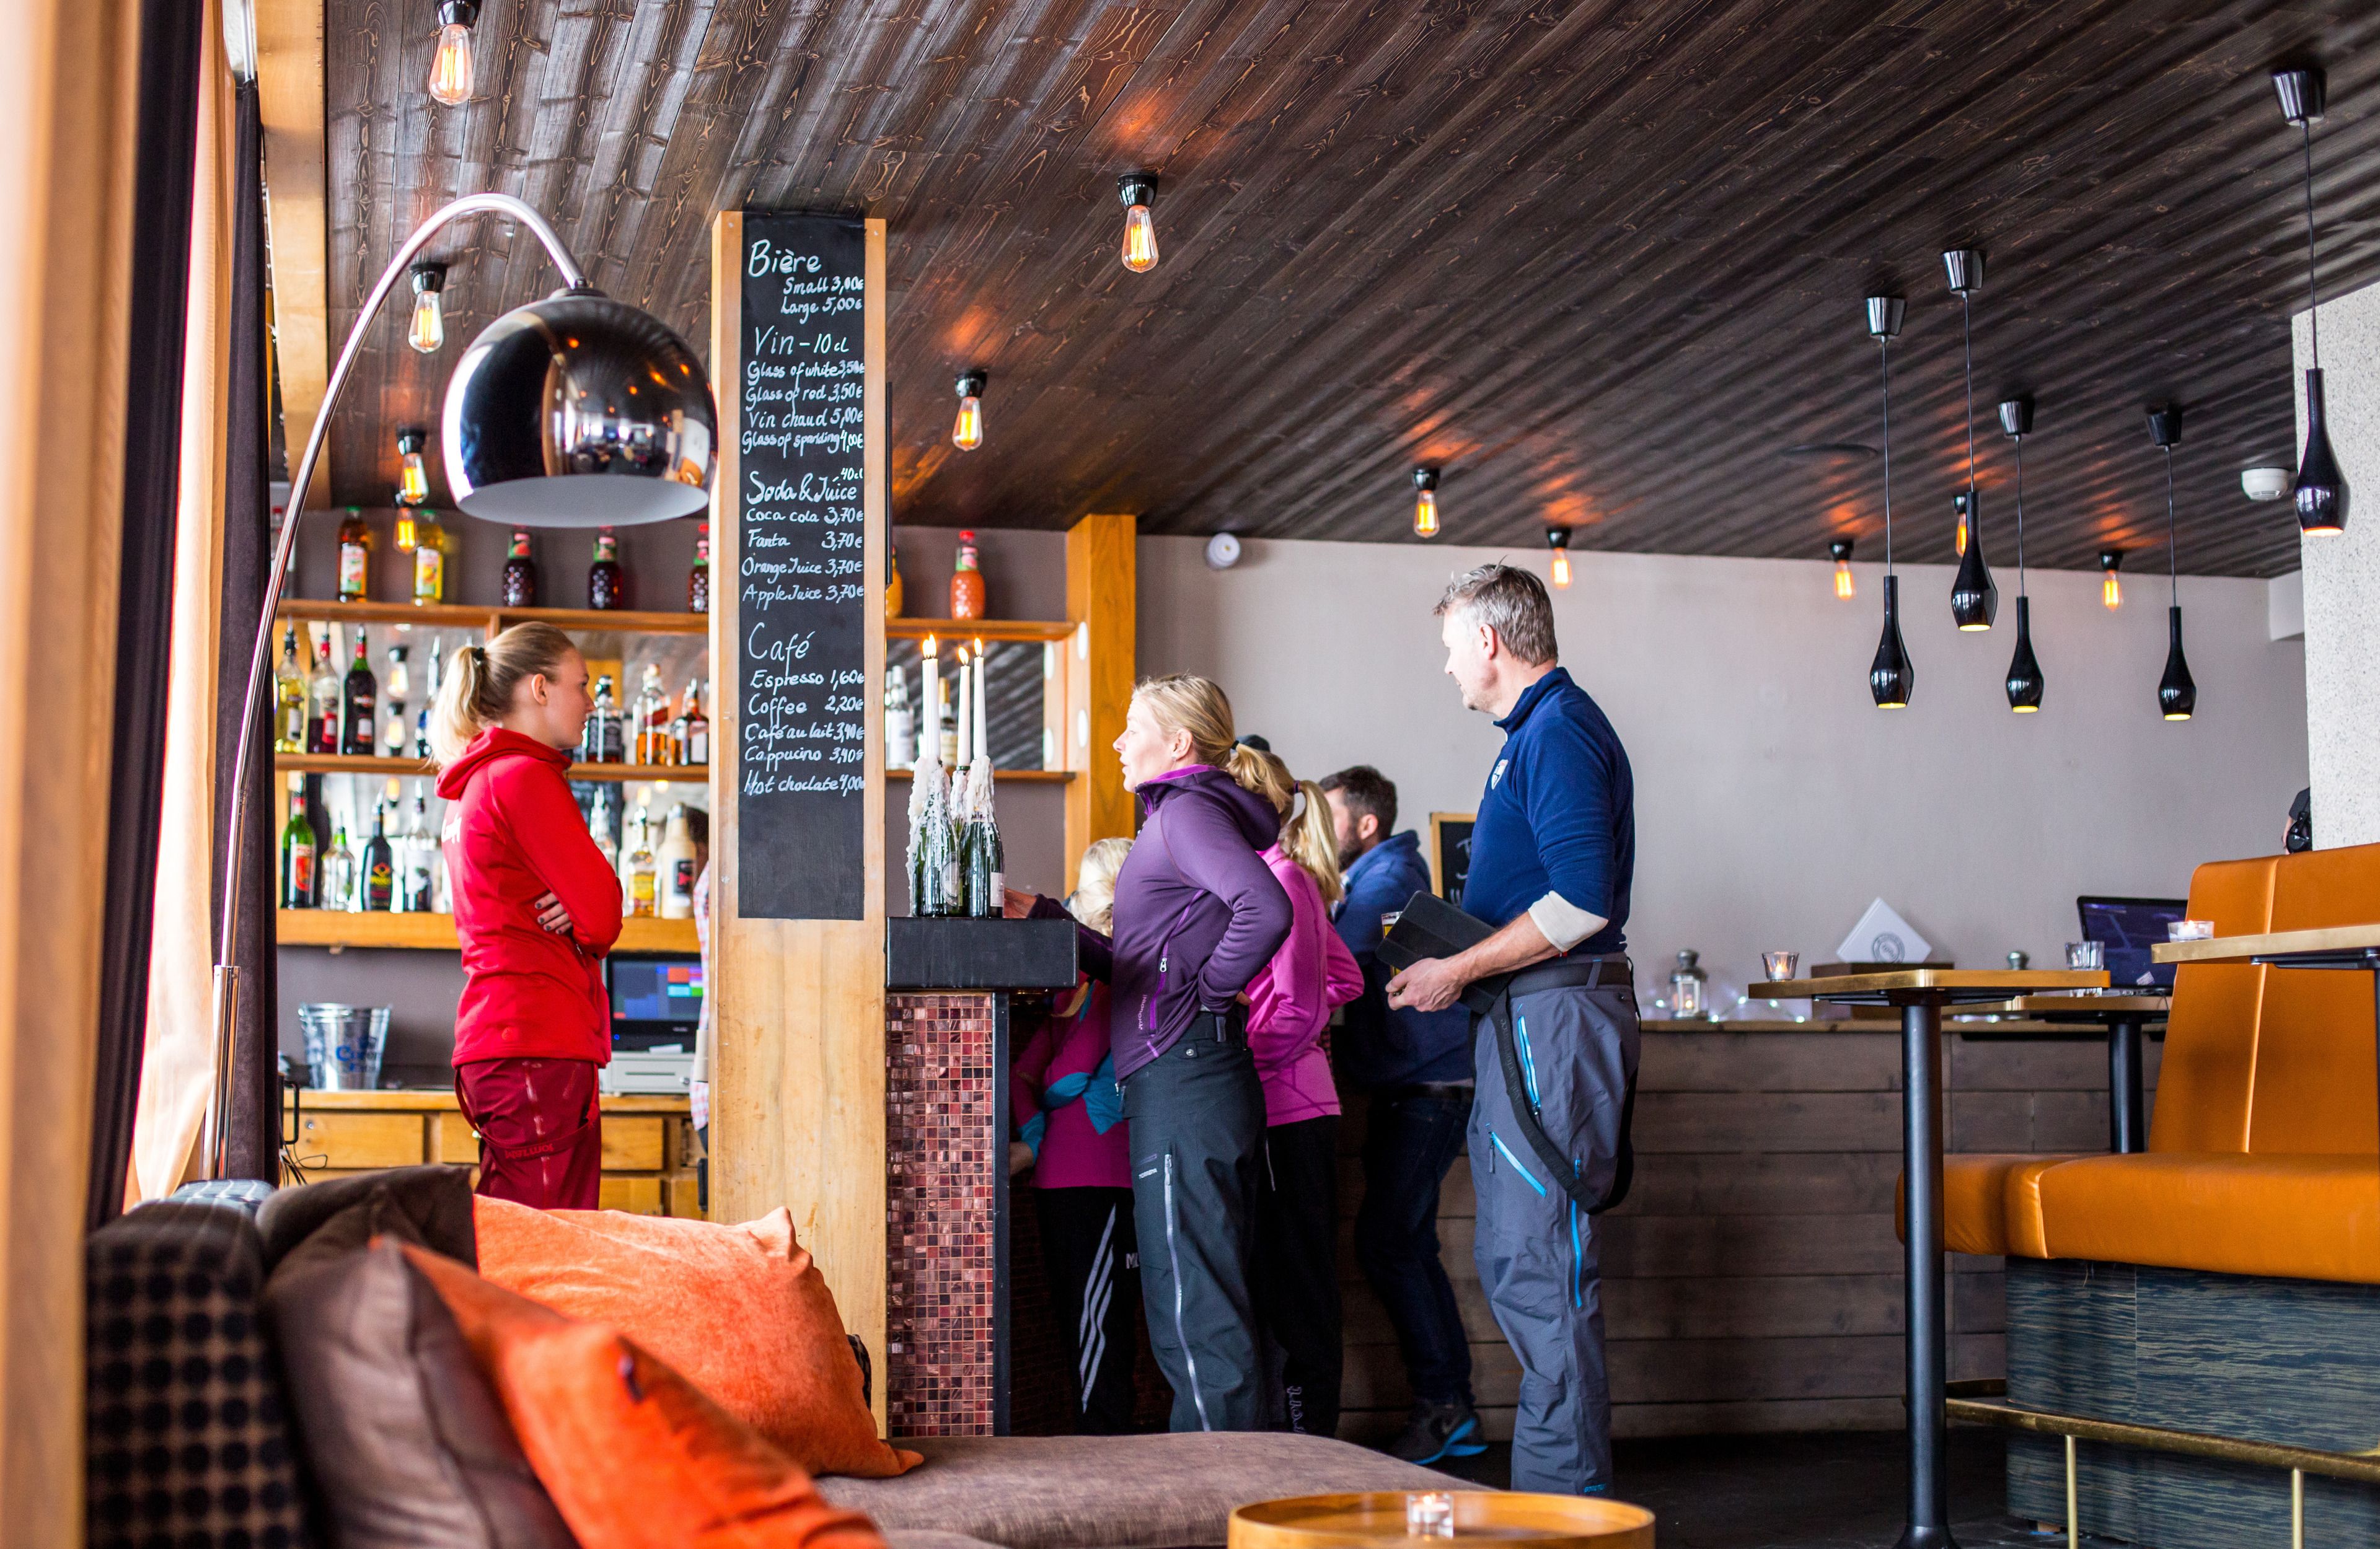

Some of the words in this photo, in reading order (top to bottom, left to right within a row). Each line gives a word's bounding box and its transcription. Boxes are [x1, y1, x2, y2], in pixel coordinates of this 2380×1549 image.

[748, 239, 822, 278] Bière
[783, 276, 829, 295] Small
[780, 296, 819, 325] Large
[822, 296, 863, 316] 5,00€
[755, 325, 795, 356] Vin
[747, 361, 786, 386] Glass
[790, 361, 805, 389] of
[805, 361, 838, 378] white
[745, 386, 783, 412] Glass
[784, 387, 801, 413] of
[827, 382, 863, 403] 3,50€
[749, 411, 776, 429] Vin
[781, 407, 828, 429] chaud
[829, 406, 863, 429] 5,00€
[741, 430, 777, 455] Glass
[777, 432, 792, 459] of
[840, 429, 863, 454] 4,00€
[746, 470, 797, 505] Soda
[798, 472, 814, 502] &
[813, 476, 858, 502] Juice
[746, 507, 787, 522] Coca
[789, 511, 819, 524] cola
[824, 506, 864, 527] 3,70€
[747, 527, 791, 548] Fanta
[821, 530, 863, 551] 3,70€
[741, 556, 788, 584] Orange
[788, 557, 822, 574] Juice
[824, 558, 863, 578] 3,70€
[742, 584, 788, 611] Apple
[787, 584, 822, 601] Juice
[825, 584, 865, 604] 3,70€
[747, 621, 816, 677] Café
[749, 669, 824, 696] Espresso
[829, 669, 865, 691] 1,60€
[748, 693, 808, 729] Coffee
[824, 695, 864, 715] 2,20€
[744, 722, 788, 752] Café
[786, 727, 808, 739] au
[809, 722, 835, 739] lait
[744, 745, 822, 772] Cappucino
[829, 747, 865, 764] 3,40€
[744, 769, 775, 796] Hot
[778, 775, 839, 792] choclate
